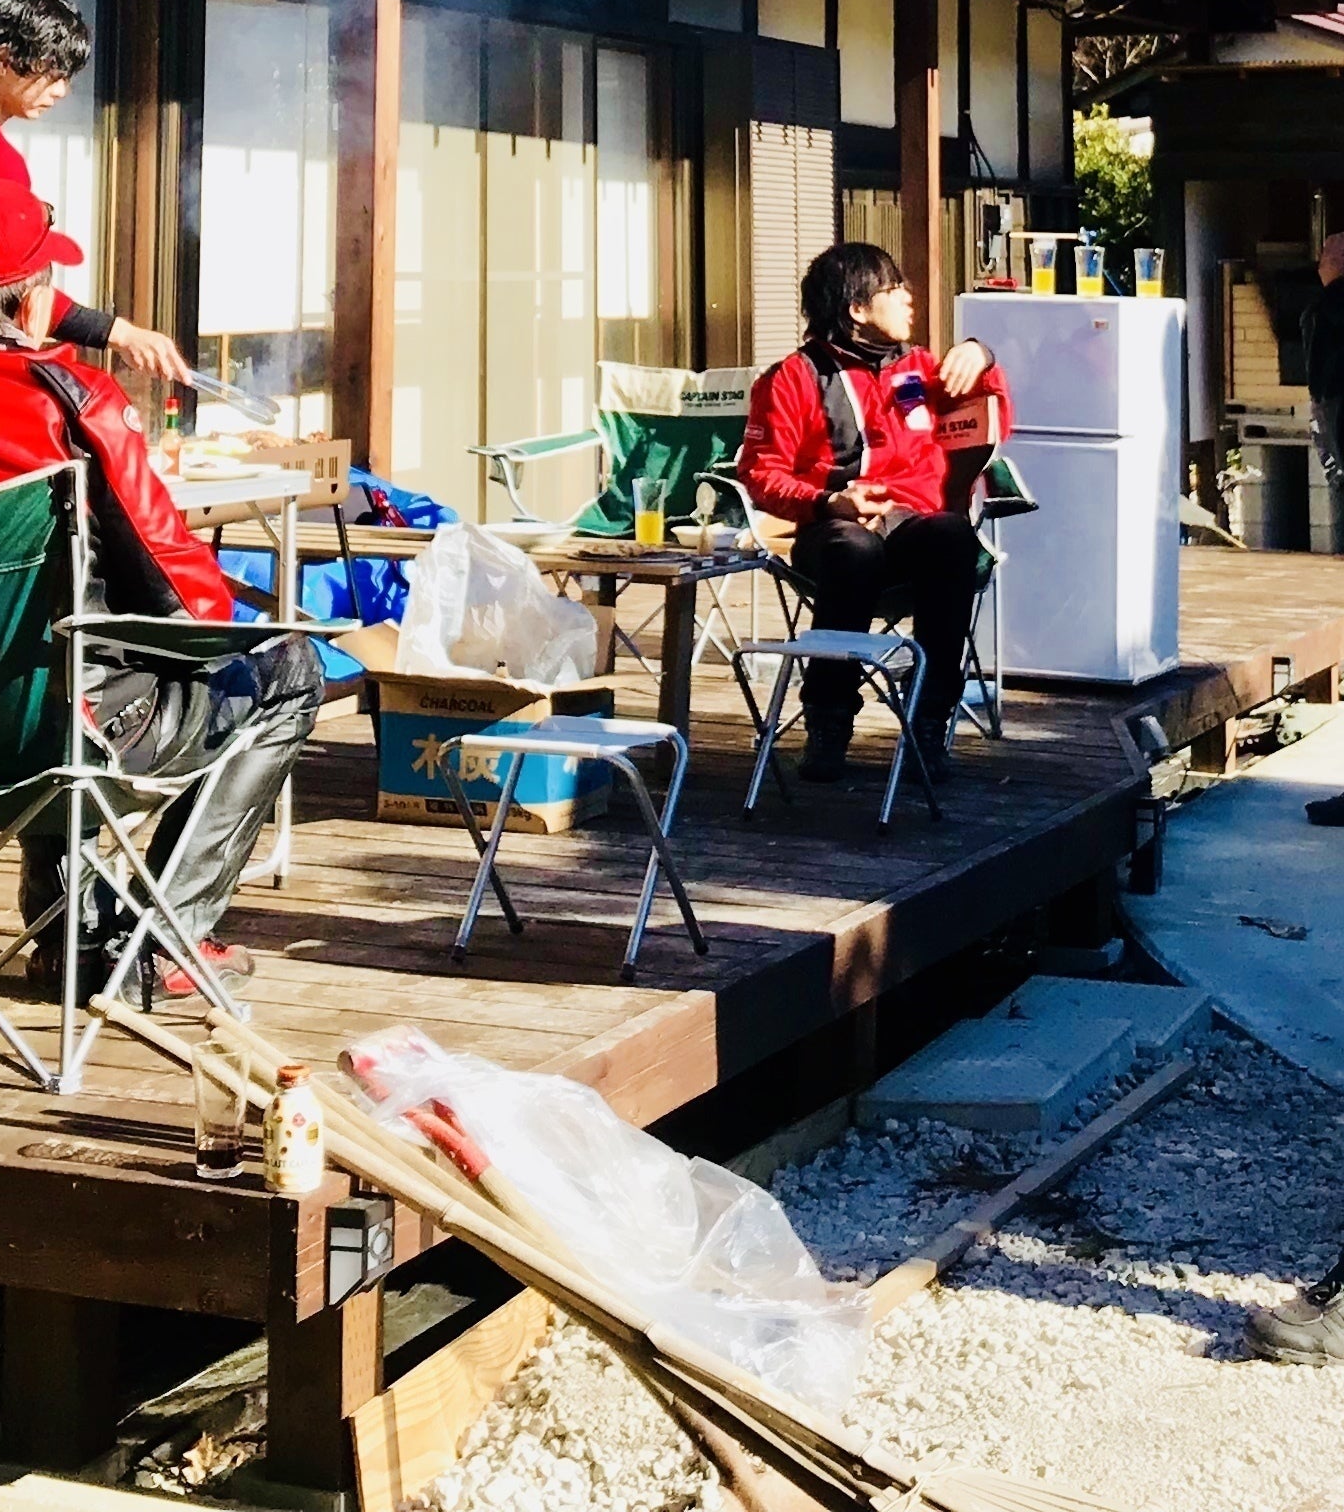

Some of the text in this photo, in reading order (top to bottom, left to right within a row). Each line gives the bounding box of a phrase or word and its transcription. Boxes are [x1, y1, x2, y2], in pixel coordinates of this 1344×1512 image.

[680, 390, 744, 401] CAPTAIN STAG
[949, 418, 977, 431] STAG
[420, 695, 495, 713] CHARCOAL
